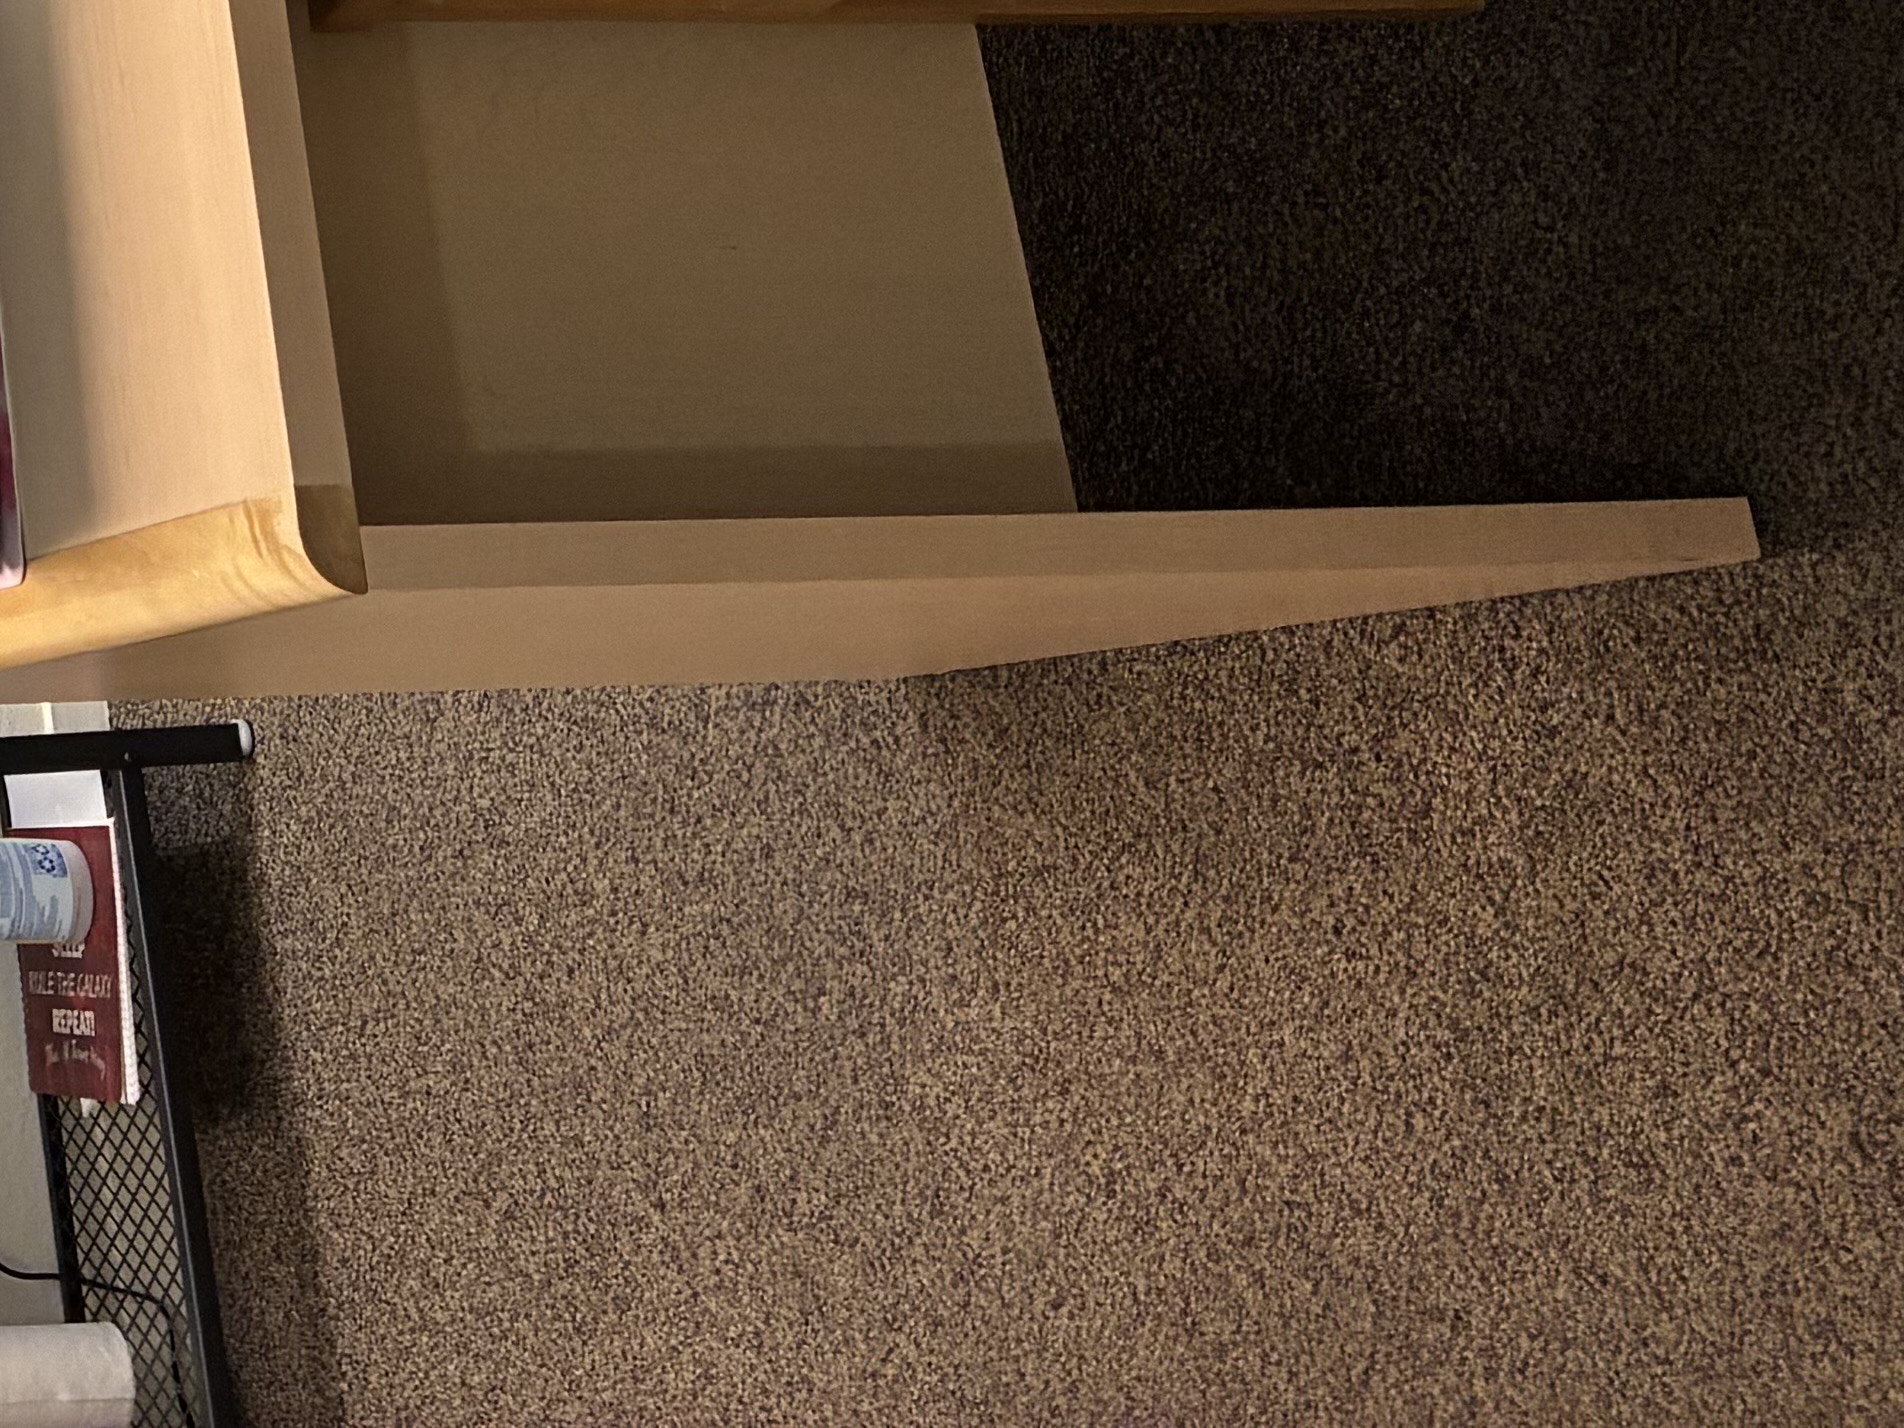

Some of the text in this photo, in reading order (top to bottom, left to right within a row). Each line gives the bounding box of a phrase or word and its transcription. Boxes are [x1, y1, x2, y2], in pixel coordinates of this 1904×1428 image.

[28, 970, 55, 995] RULE
[56, 971, 76, 997] THE
[51, 1008, 96, 1037] REPEAT!
